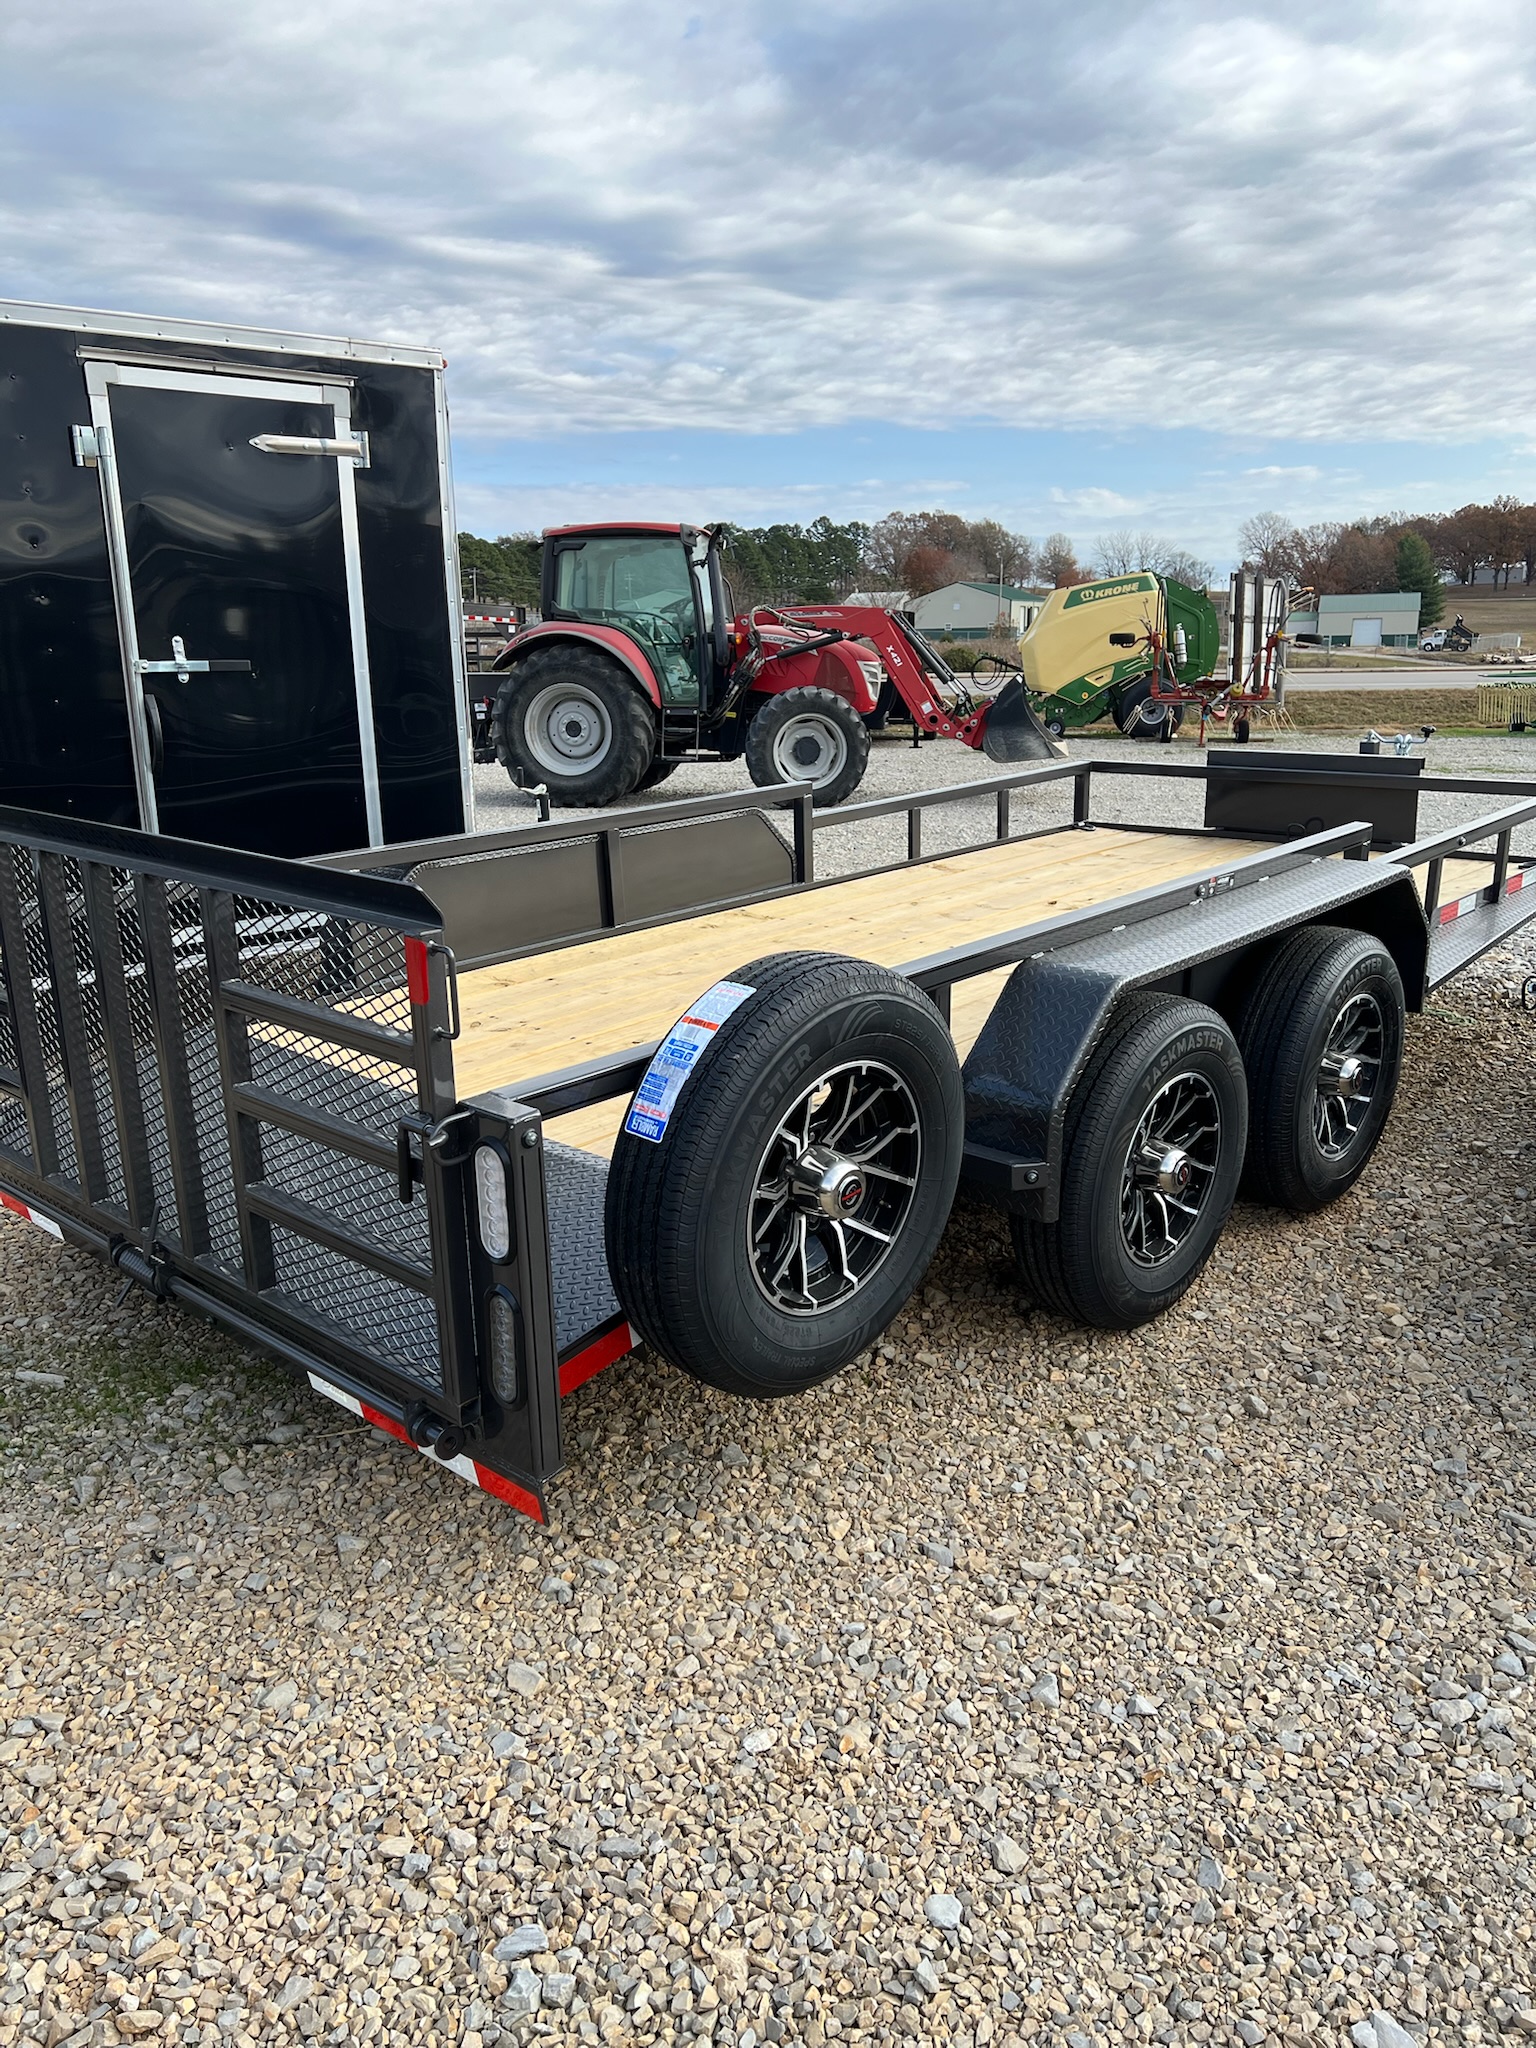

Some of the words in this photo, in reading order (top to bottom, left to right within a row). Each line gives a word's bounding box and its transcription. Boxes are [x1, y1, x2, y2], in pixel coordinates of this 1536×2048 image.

[1095, 582, 1139, 599] KRONE
[1323, 957, 1383, 1031] TASKMASTER
[1142, 1030, 1224, 1090] TASKMASTER
[711, 1043, 814, 1249] TASKMASTER
[1148, 1258, 1204, 1312] RAMBLER
[751, 1336, 781, 1365] TRAILER
[783, 1355, 817, 1369] SPECIAL
